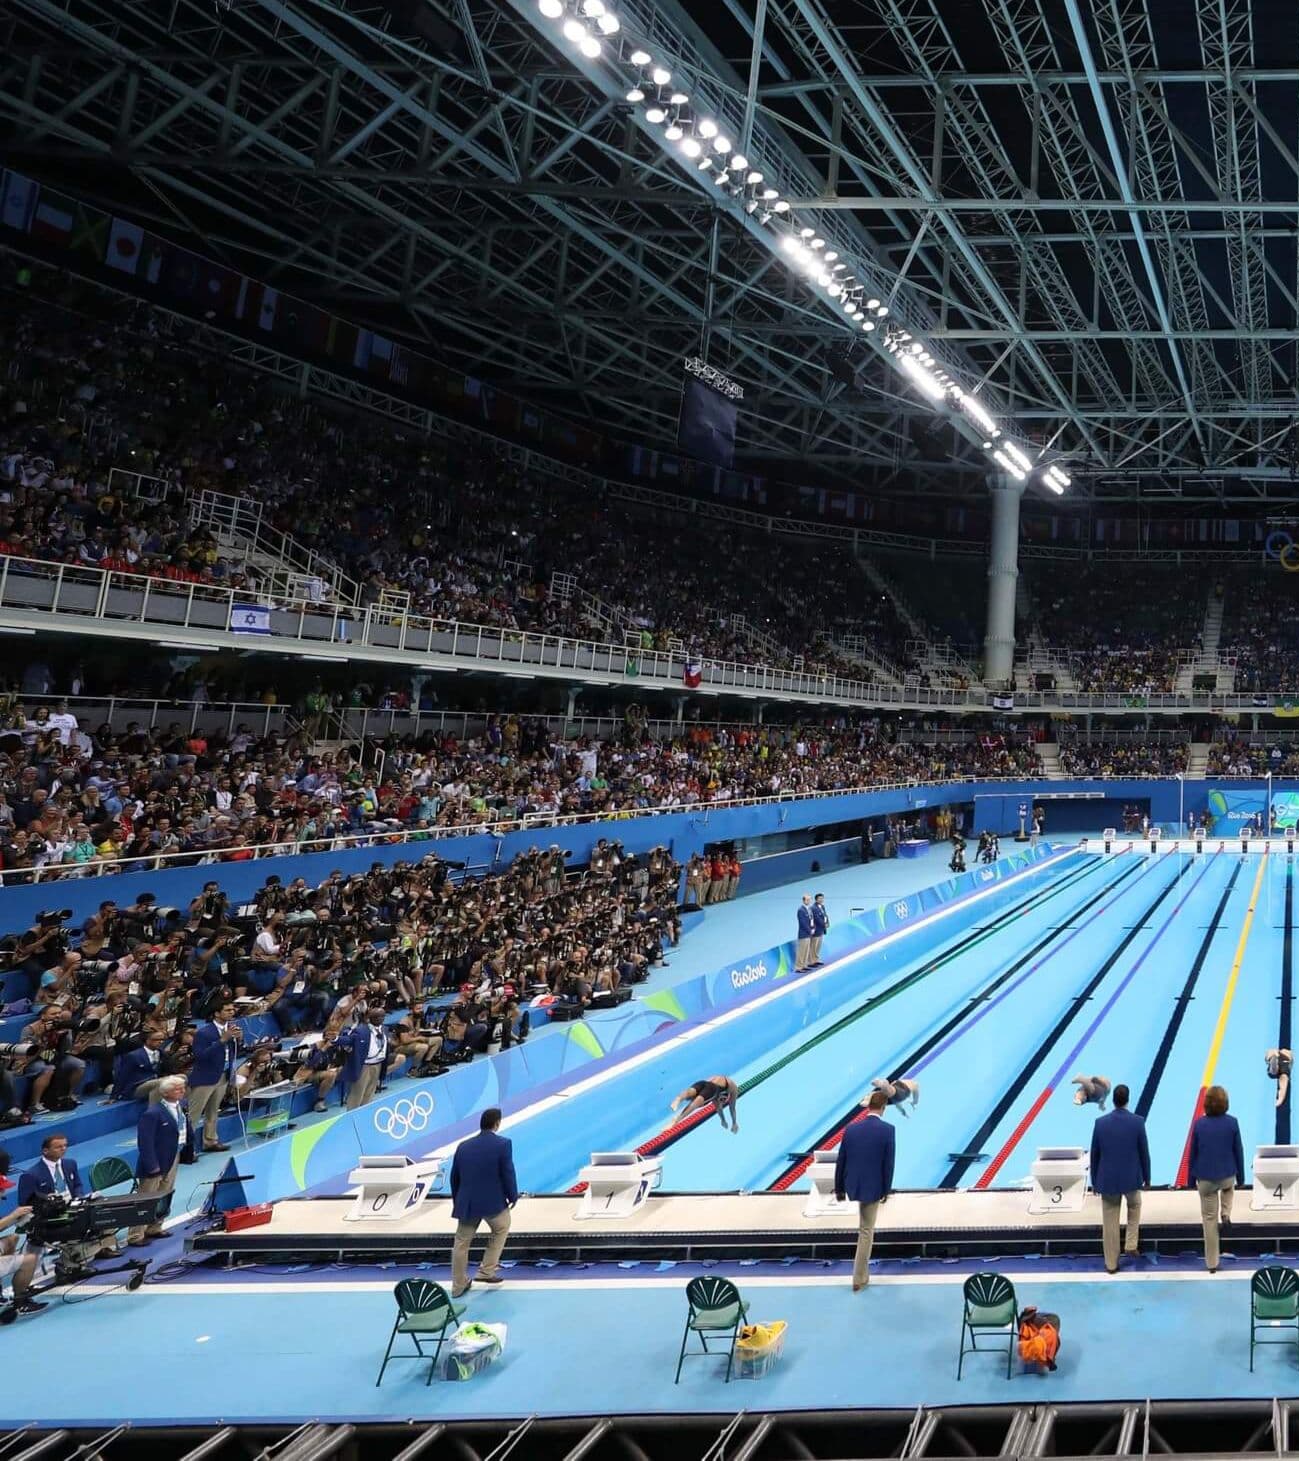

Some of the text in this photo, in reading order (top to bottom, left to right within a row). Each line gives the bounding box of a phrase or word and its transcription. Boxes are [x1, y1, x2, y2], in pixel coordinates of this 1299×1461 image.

[605, 1191, 615, 1209] 1
[1051, 1185, 1063, 1203] 3
[1273, 1183, 1284, 1201] 4
[372, 1193, 388, 1211] 0
